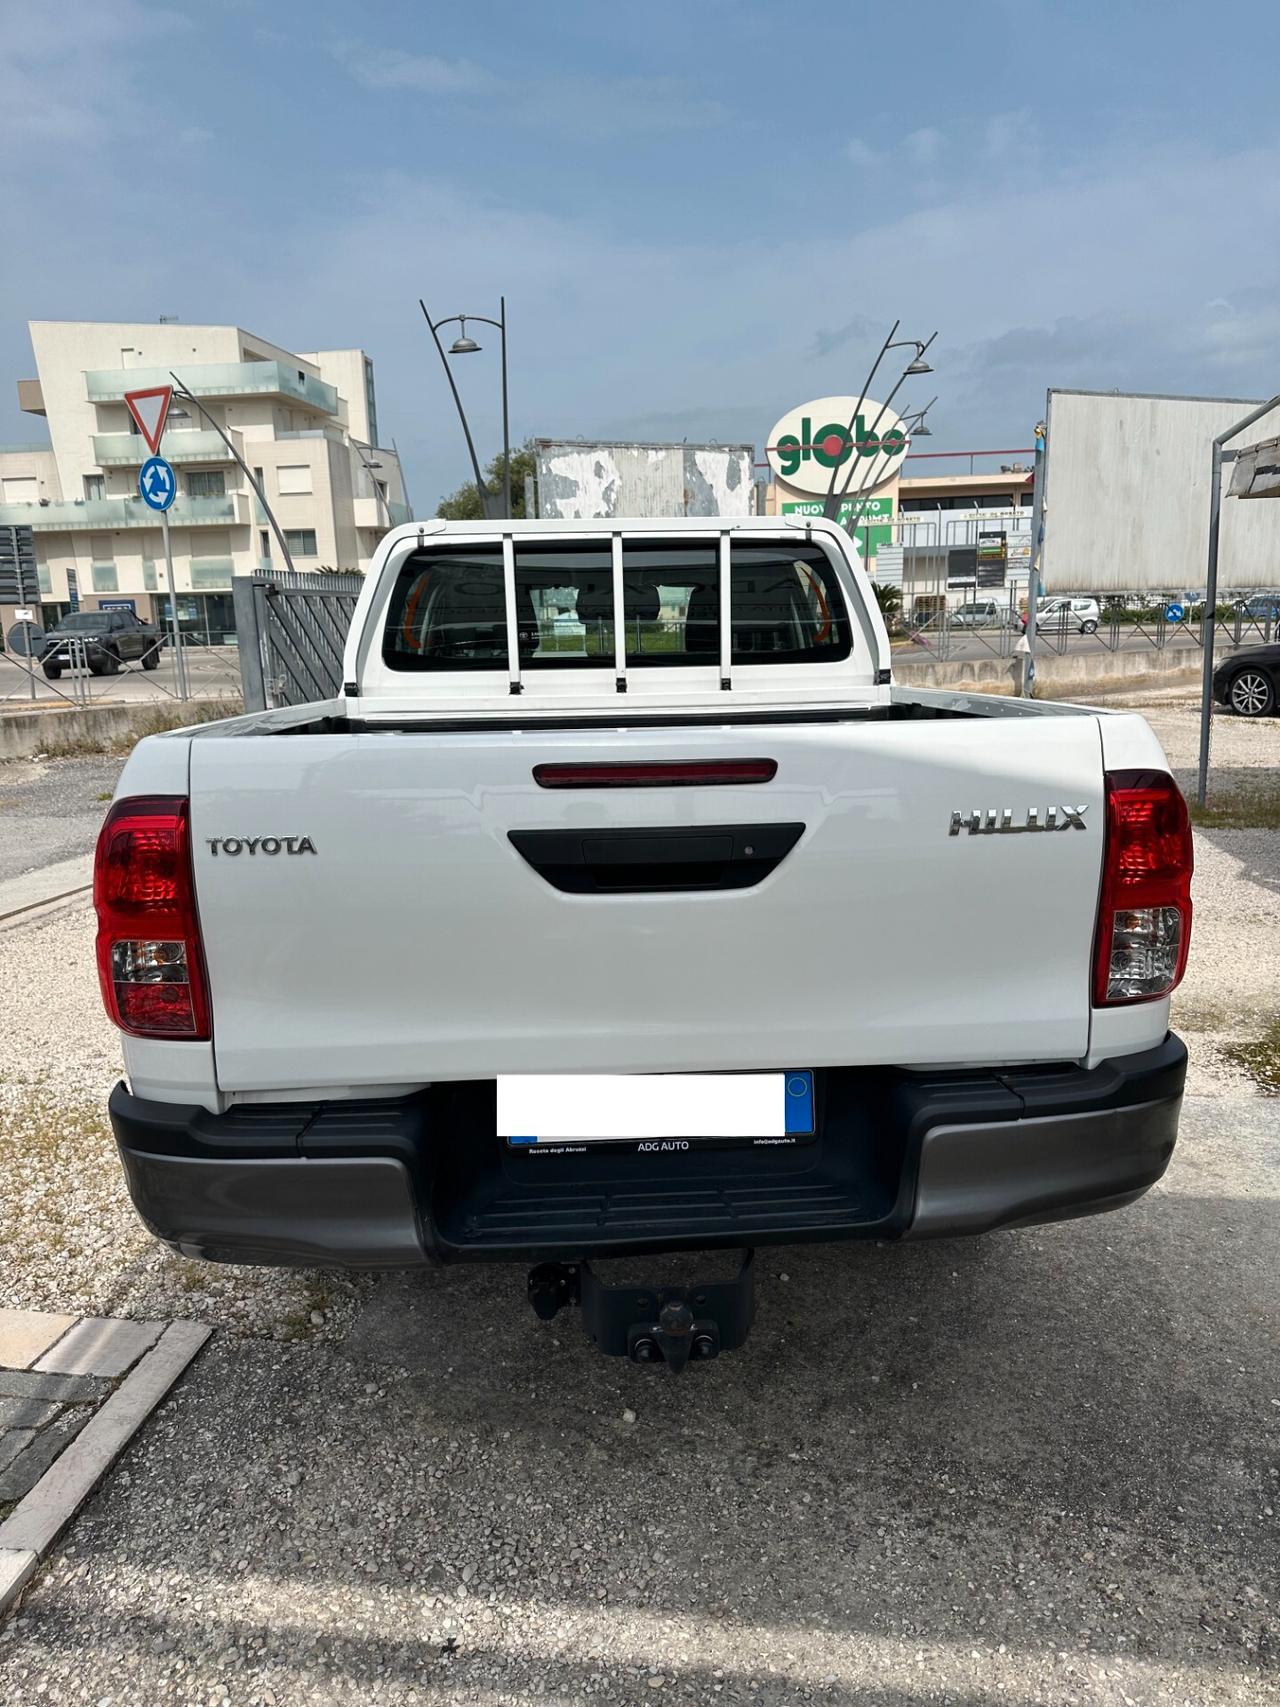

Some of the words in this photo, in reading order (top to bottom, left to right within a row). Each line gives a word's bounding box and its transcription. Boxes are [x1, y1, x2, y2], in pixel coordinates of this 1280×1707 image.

[776, 415, 906, 476] globo
[949, 805, 1089, 836] HILUX
[205, 835, 318, 857] TOYOTA
[637, 1142, 659, 1151] ADG
[661, 1141, 689, 1151] AUTO
